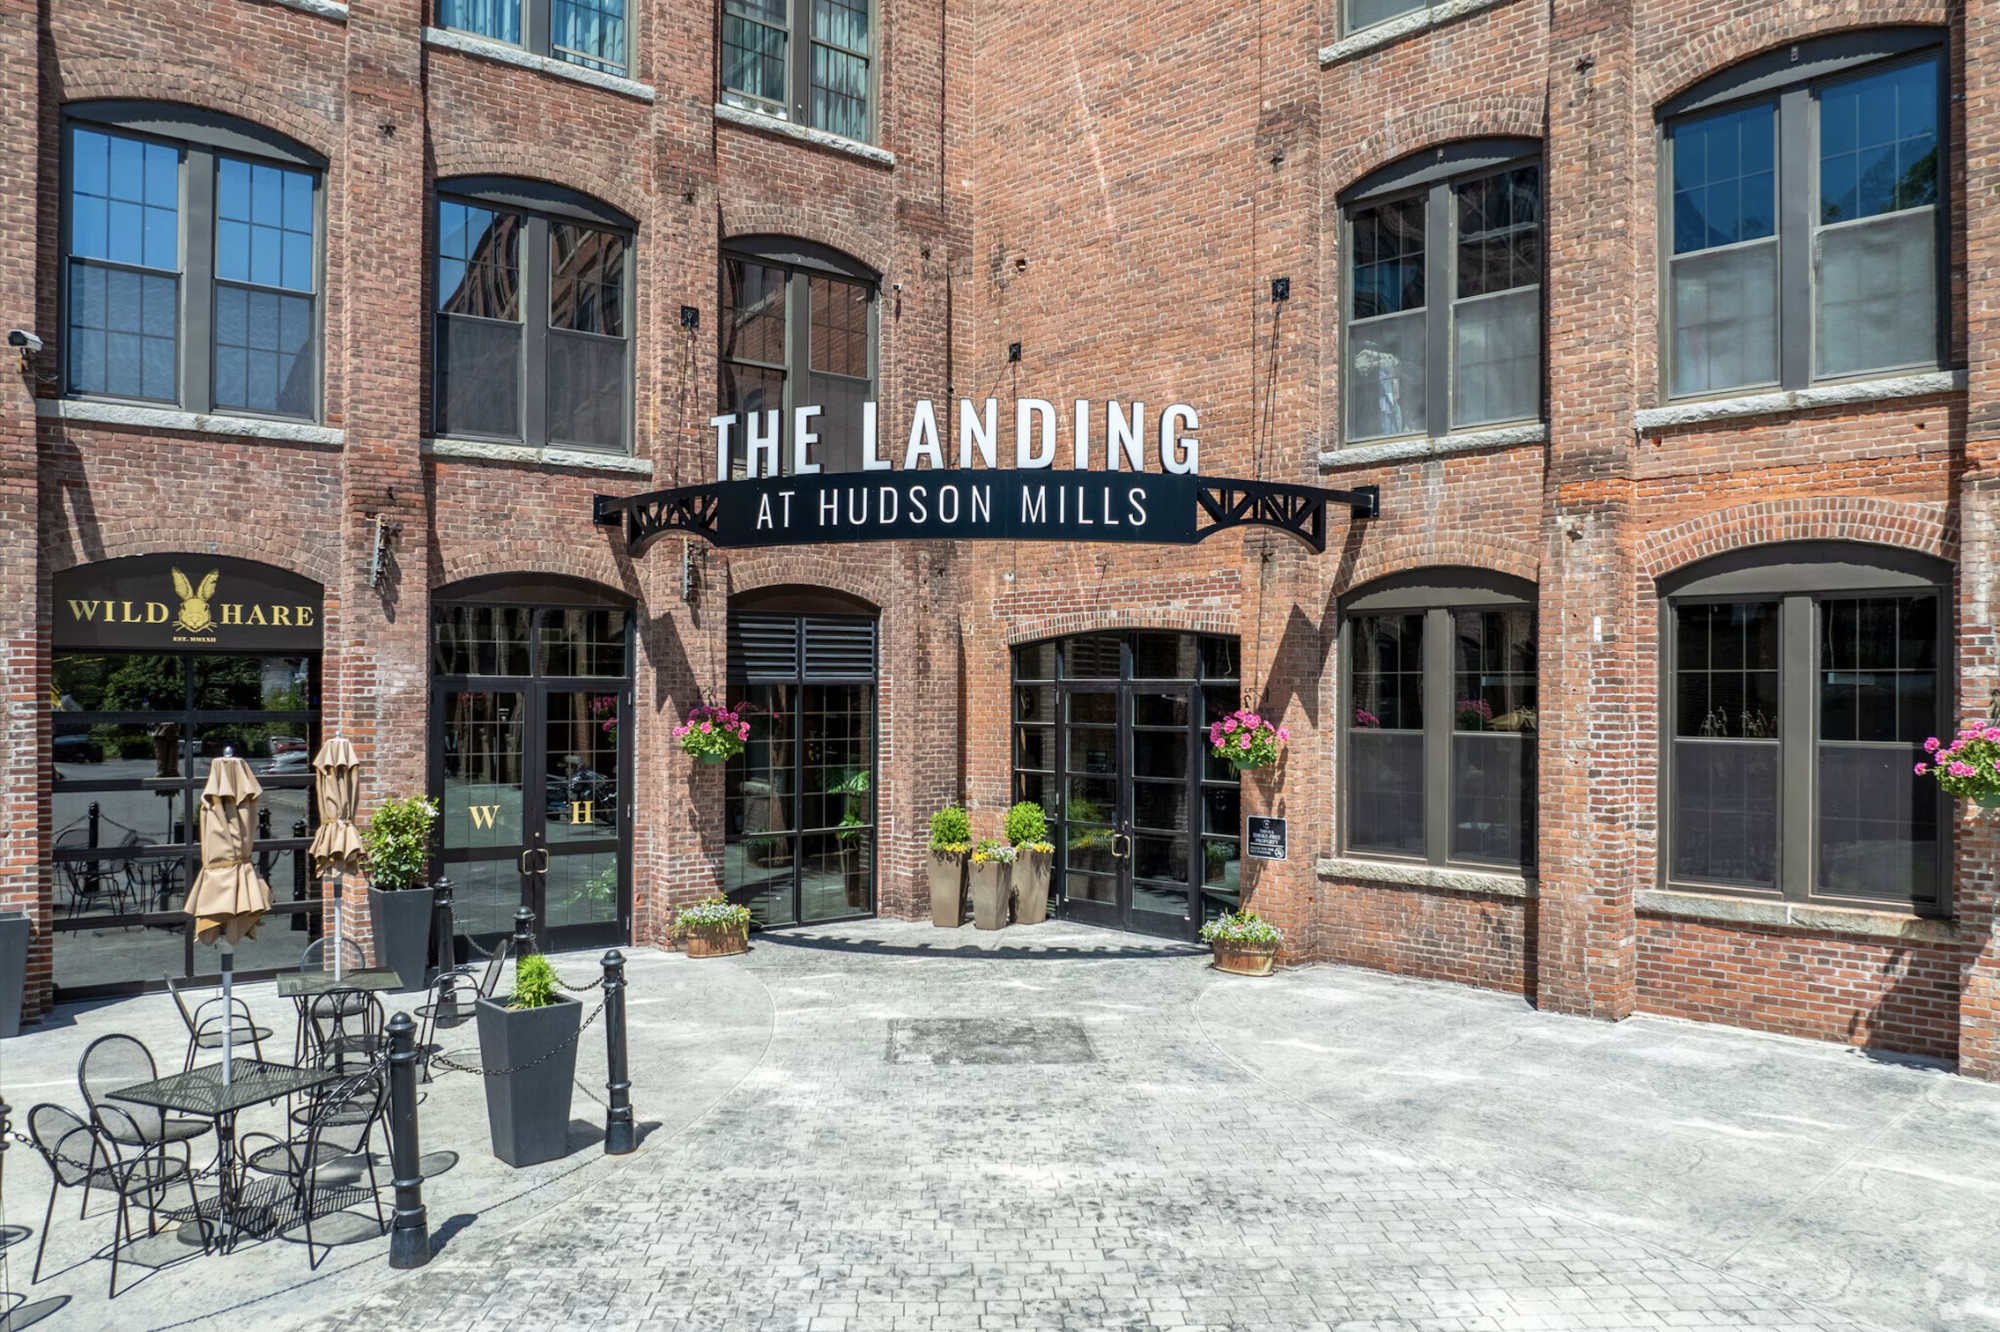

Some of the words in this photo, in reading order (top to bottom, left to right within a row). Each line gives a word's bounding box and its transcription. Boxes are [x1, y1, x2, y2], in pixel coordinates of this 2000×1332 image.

[710, 404, 823, 482] THE
[862, 398, 1199, 475] LANDING
[756, 491, 796, 530] AT
[818, 484, 991, 526] HUDSON
[1021, 484, 1148, 526] MILLS
[67, 600, 169, 624] WILD
[220, 603, 314, 627] HARE
[468, 804, 500, 830] W
[570, 800, 593, 824] H
